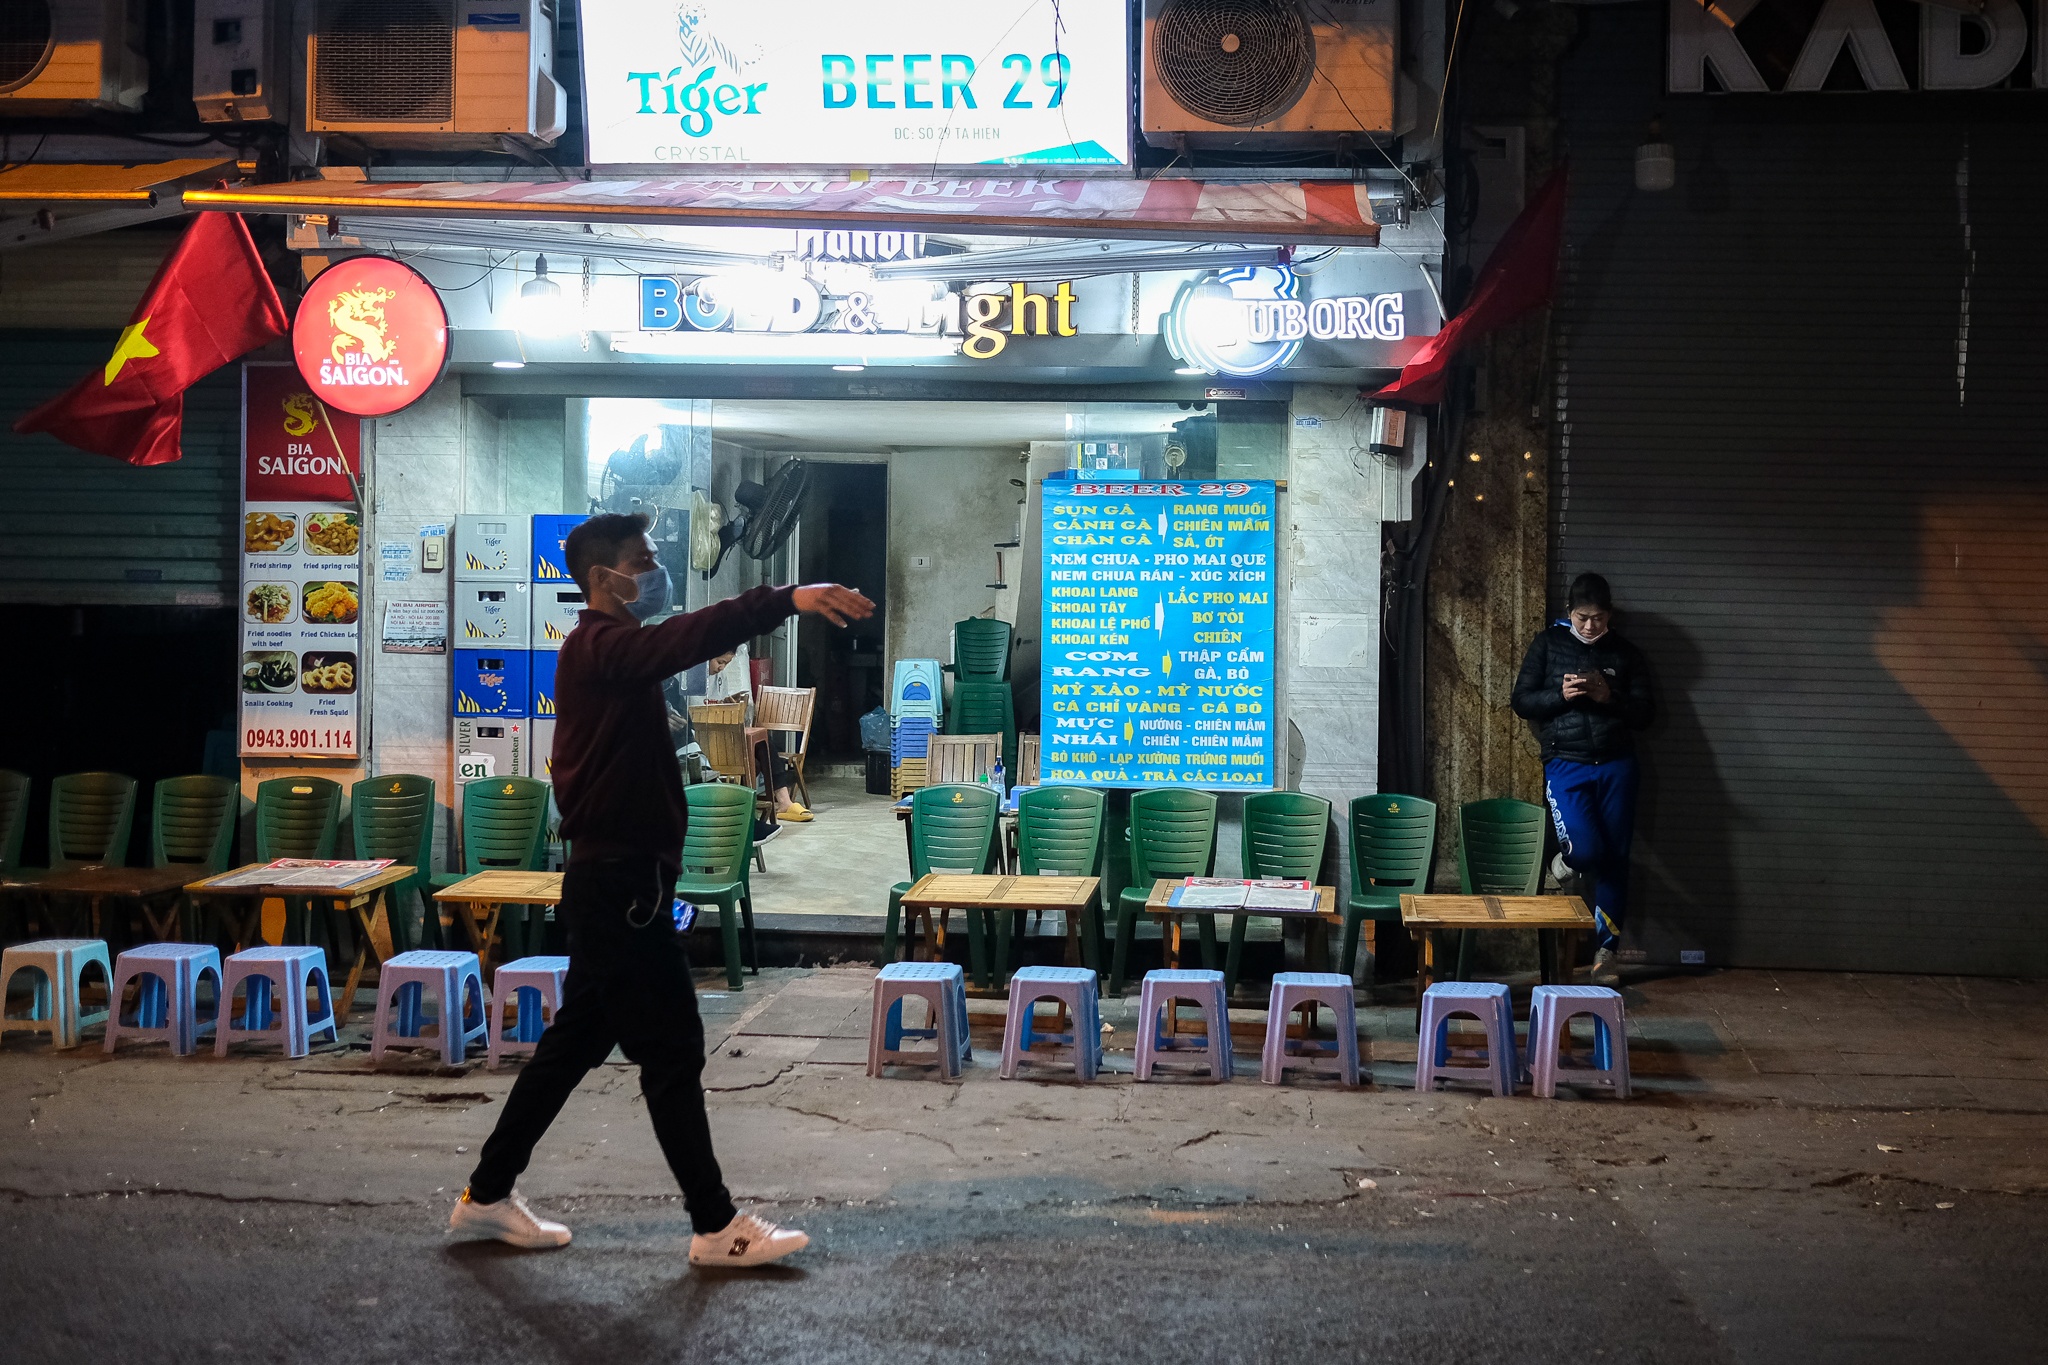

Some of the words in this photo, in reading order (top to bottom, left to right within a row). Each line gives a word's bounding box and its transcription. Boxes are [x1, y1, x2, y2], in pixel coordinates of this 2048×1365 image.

[822, 54, 978, 109] BEER
[1001, 53, 1071, 109] 29
[627, 66, 768, 137] Tiger
[654, 146, 750, 162] CRYSTAL
[843, 291, 880, 334] &
[1243, 293, 1405, 341] UBORG
[345, 353, 372, 365] BIA
[288, 443, 313, 455] BIA
[1070, 483, 1187, 496] BEER
[1198, 483, 1251, 497] 29
[1104, 504, 1134, 514] GÀ
[1174, 505, 1218, 514] RANG
[1224, 503, 1266, 514] MUỐI
[1053, 519, 1114, 530] CÁNH
[1121, 519, 1152, 530] GÀ
[1174, 519, 1222, 531] CHIÊN
[485, 538, 502, 546] Tiger
[1053, 534, 1114, 545] CHÂN
[1121, 534, 1152, 544] GÀ
[1051, 554, 1087, 564] NEM
[1092, 554, 1140, 565] CHUA
[1154, 554, 1188, 565] PHO
[1194, 554, 1226, 565] MAI
[1231, 554, 1266, 567] QUE
[1051, 571, 1086, 580] NEM
[1092, 571, 1135, 580] CHUA
[1140, 569, 1173, 581] RÁN
[1191, 570, 1222, 581] XÚC
[1229, 570, 1265, 581] XÍCH
[1052, 587, 1095, 597] KHOAI
[1100, 588, 1138, 597] LANG
[1203, 593, 1234, 603] PHO
[1239, 593, 1268, 603] MAI
[484, 606, 501, 614] Tiger
[563, 607, 578, 616] Tige
[1052, 603, 1095, 612] KHOAI
[1100, 601, 1126, 613] TÂY
[1052, 619, 1095, 628] KHOAI
[1193, 612, 1213, 623] BƠ
[1052, 634, 1095, 644] KHOAI
[1194, 629, 1242, 643] CHIÊN
[1065, 651, 1138, 661] CƠM
[1179, 650, 1221, 664] THẬP
[1052, 667, 1151, 677] RANG
[1227, 667, 1249, 679] BÒ
[478, 673, 505, 687] Tiger
[1091, 682, 1139, 696] XÀO
[1198, 683, 1262, 696] NƯỚC
[266, 700, 293, 708] Cooking
[1054, 700, 1079, 711] CÁ
[1126, 701, 1180, 712] VÀNG
[1202, 702, 1228, 713] CÁ
[1236, 702, 1262, 713] BÒ
[1057, 718, 1113, 730] MỰC
[1195, 719, 1231, 730] CHIÊN
[246, 729, 352, 748] 0943.901.114
[459, 721, 471, 754] SILVER
[1052, 732, 1117, 745] NHÁI
[1143, 734, 1179, 746] CHIÊN
[1192, 735, 1228, 746] CHIÊN
[1051, 751, 1068, 762] BÒ
[1072, 751, 1096, 762] KHÔ
[1231, 753, 1264, 765] MUỐI
[459, 763, 487, 777] en
[1051, 770, 1088, 781] HOA
[1142, 770, 1177, 781] TRÀ
